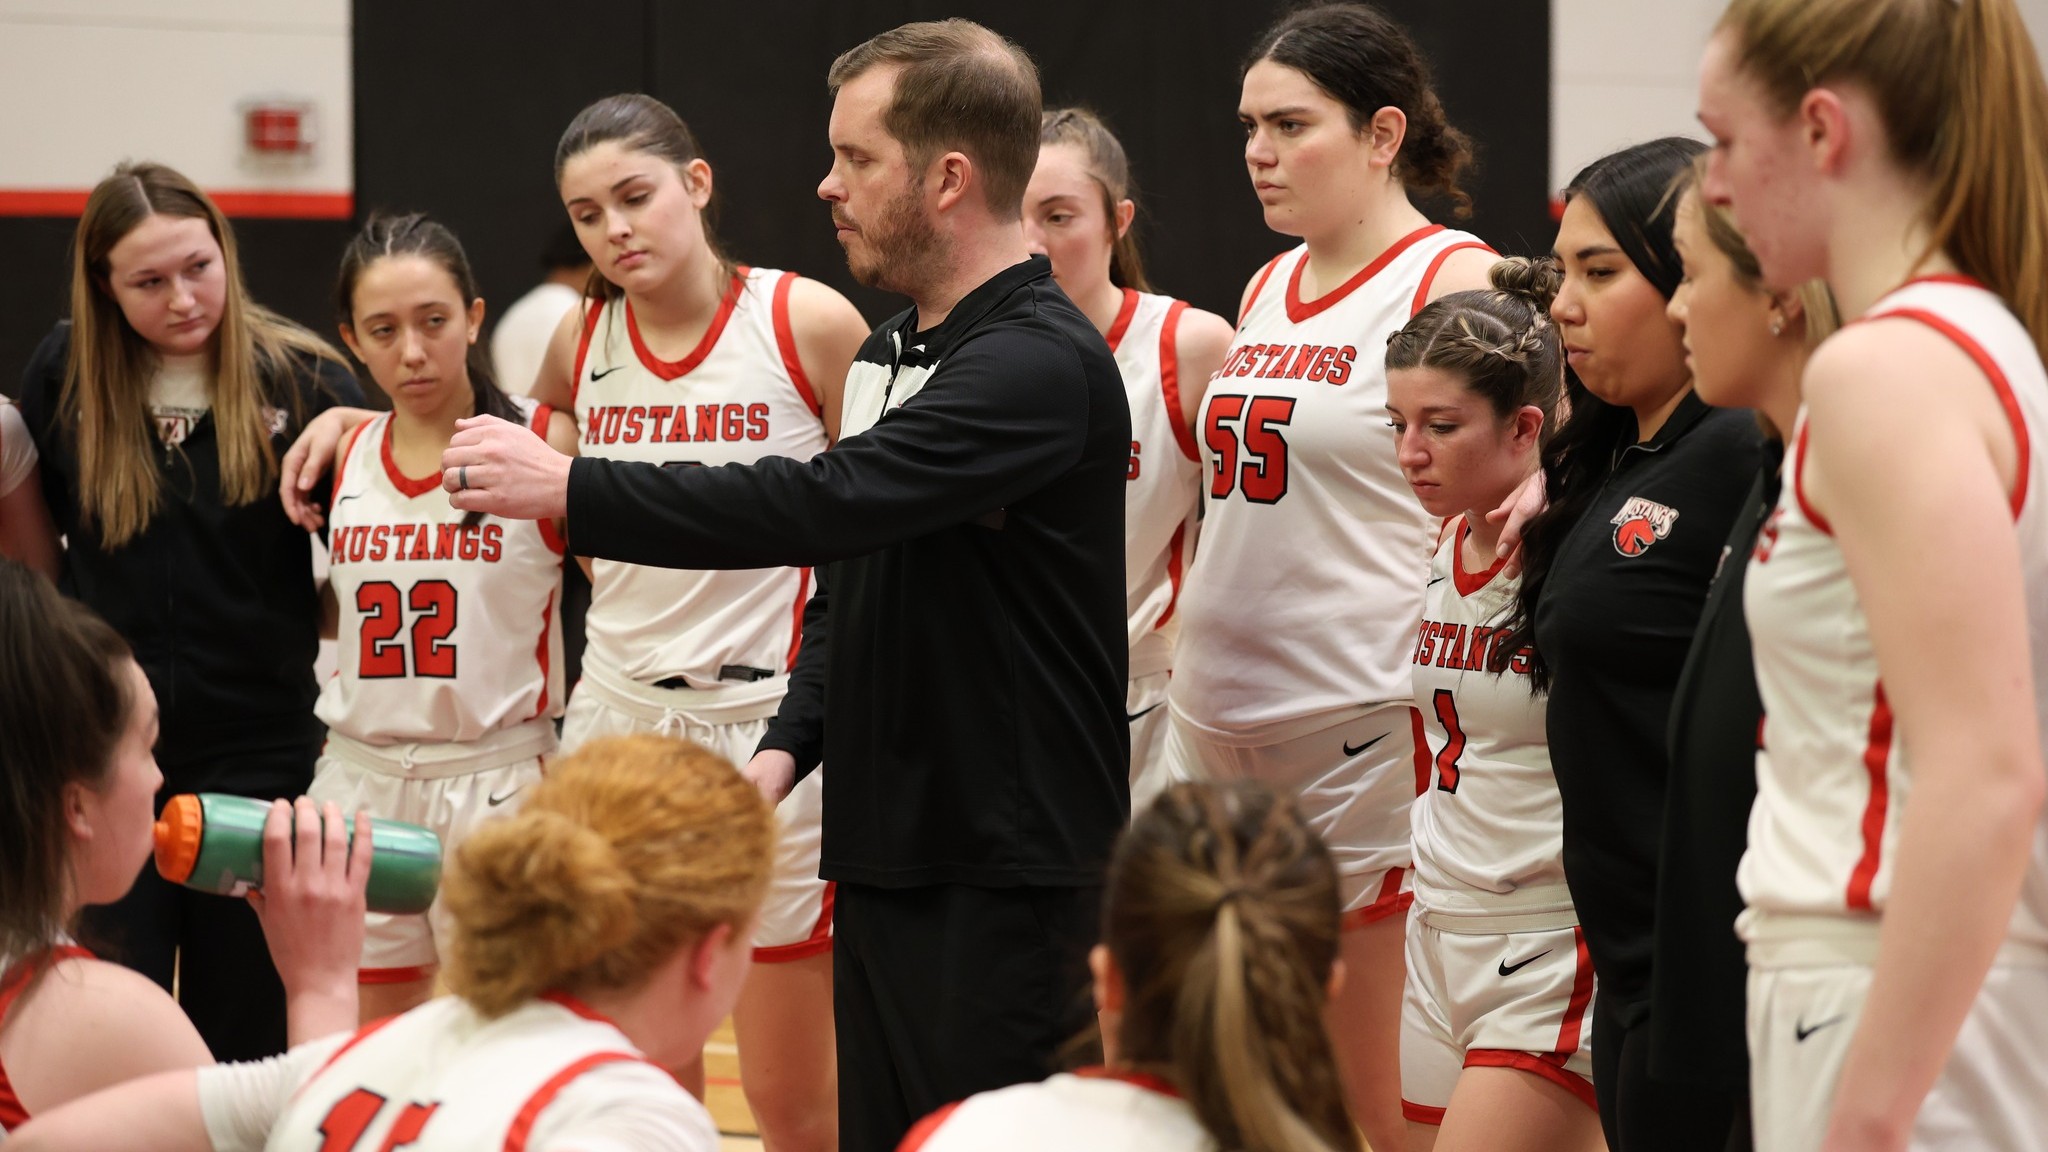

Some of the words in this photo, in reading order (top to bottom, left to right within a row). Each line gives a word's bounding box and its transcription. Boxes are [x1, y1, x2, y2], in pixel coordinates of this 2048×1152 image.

[1211, 343, 1357, 386] USTANGS
[585, 403, 770, 445] MUSTANGS
[1205, 393, 1297, 505] 55
[1610, 497, 1680, 539] MUSTANGS
[331, 524, 503, 566] MUSTANGS
[356, 580, 458, 679] 22
[1433, 688, 1467, 794] 1
